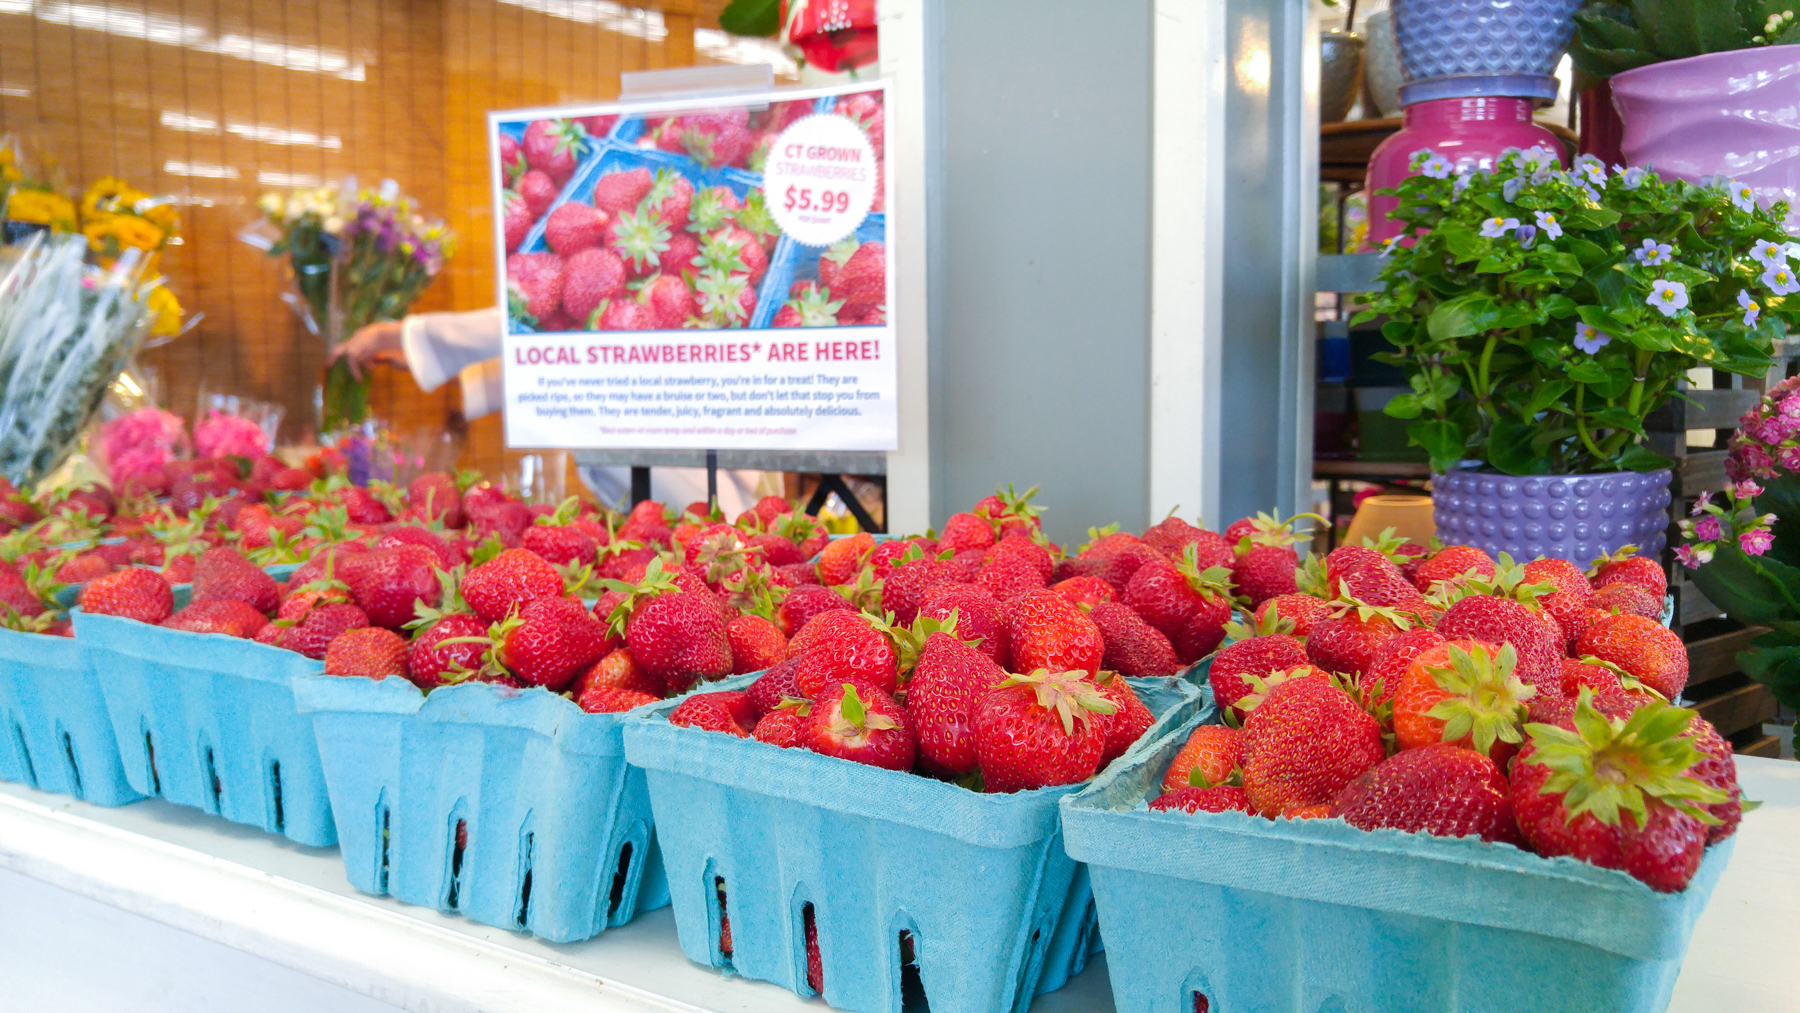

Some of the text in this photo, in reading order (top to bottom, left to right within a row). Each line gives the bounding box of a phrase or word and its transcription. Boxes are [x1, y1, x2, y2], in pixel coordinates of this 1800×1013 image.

[785, 144, 861, 162] CT GROWN
[776, 161, 867, 181] STRAWBERRIES
[783, 184, 849, 213] $5.99
[516, 347, 581, 365] LOCAL
[767, 343, 808, 362] ARE
[815, 340, 880, 361] HERE!
[538, 374, 858, 389] If you've never tried a local strawberry, you're in for a treat! They are
[518, 389, 880, 404] picked ripe, so they may have a bruise or two, but don't let that stop you from
[536, 405, 862, 419] buying them. They are tender, juicy, fragrant and absolutely delicious.
